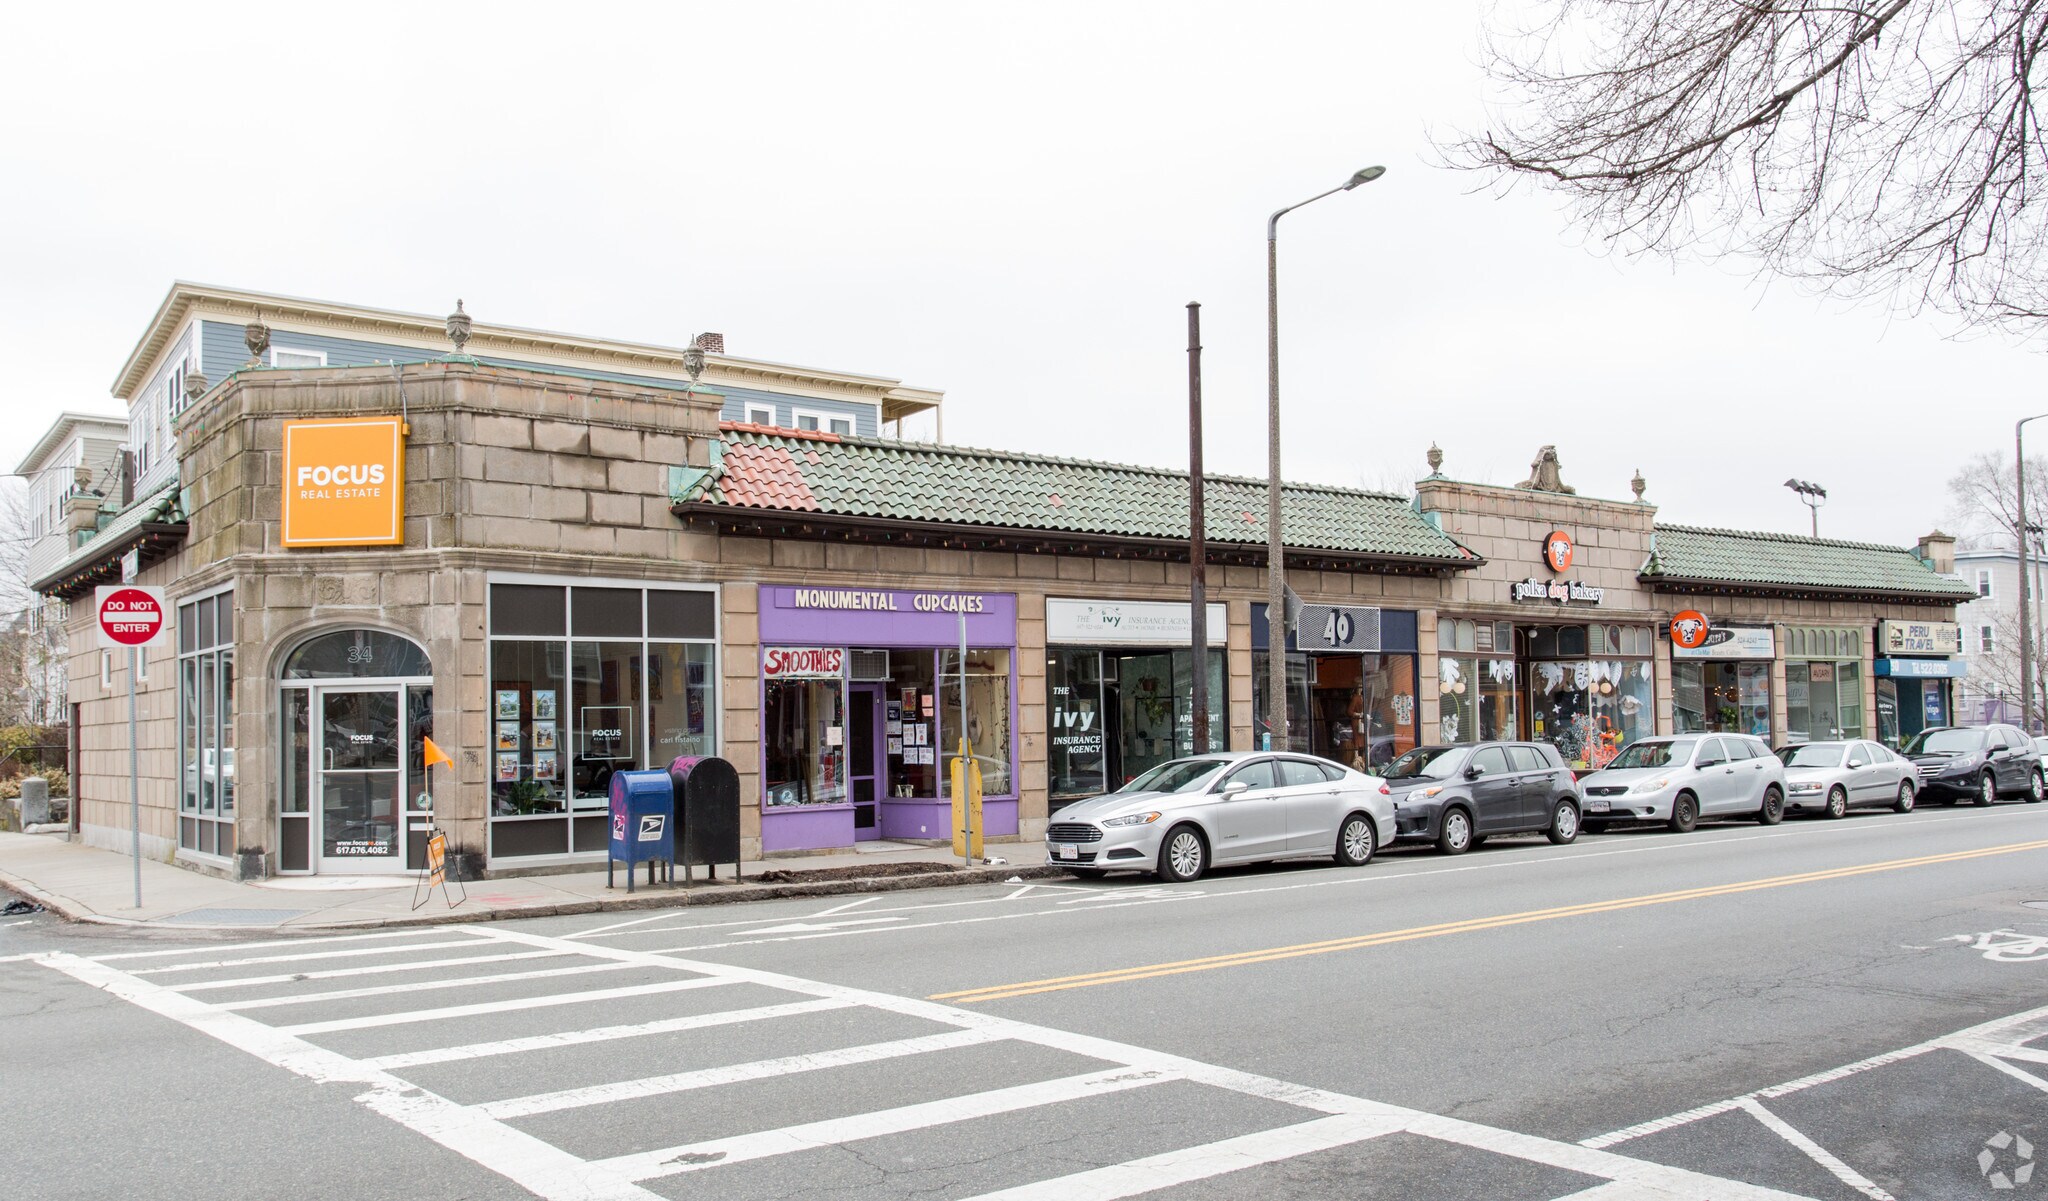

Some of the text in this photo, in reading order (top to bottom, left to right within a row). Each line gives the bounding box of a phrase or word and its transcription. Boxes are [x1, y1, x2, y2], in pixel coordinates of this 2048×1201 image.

[297, 463, 385, 487] FOCUS
[300, 487, 381, 499] REAL ESTATE
[1516, 578, 1605, 604] polka dog bakery
[107, 601, 154, 611] DO NOT
[795, 589, 984, 613] MONUMENTAL CUPCAKES
[1076, 615, 1091, 623] THE
[1102, 616, 1121, 627] ivy
[1127, 616, 1191, 626] INSURANCE AGENC
[113, 623, 150, 633] ENTER
[1323, 611, 1350, 646] 40
[1908, 625, 1930, 637] PERU
[1904, 638, 1935, 651] TRAVEL
[347, 645, 373, 663] 34
[764, 649, 842, 674] SMOOTHIES
[1053, 686, 1070, 695] THE
[1053, 706, 1095, 732] ivy
[592, 728, 622, 737] FOCUS
[1053, 735, 1101, 745] INSURANCE
[1067, 744, 1101, 754] AGENCY
[335, 846, 388, 854] 617.676.4082
